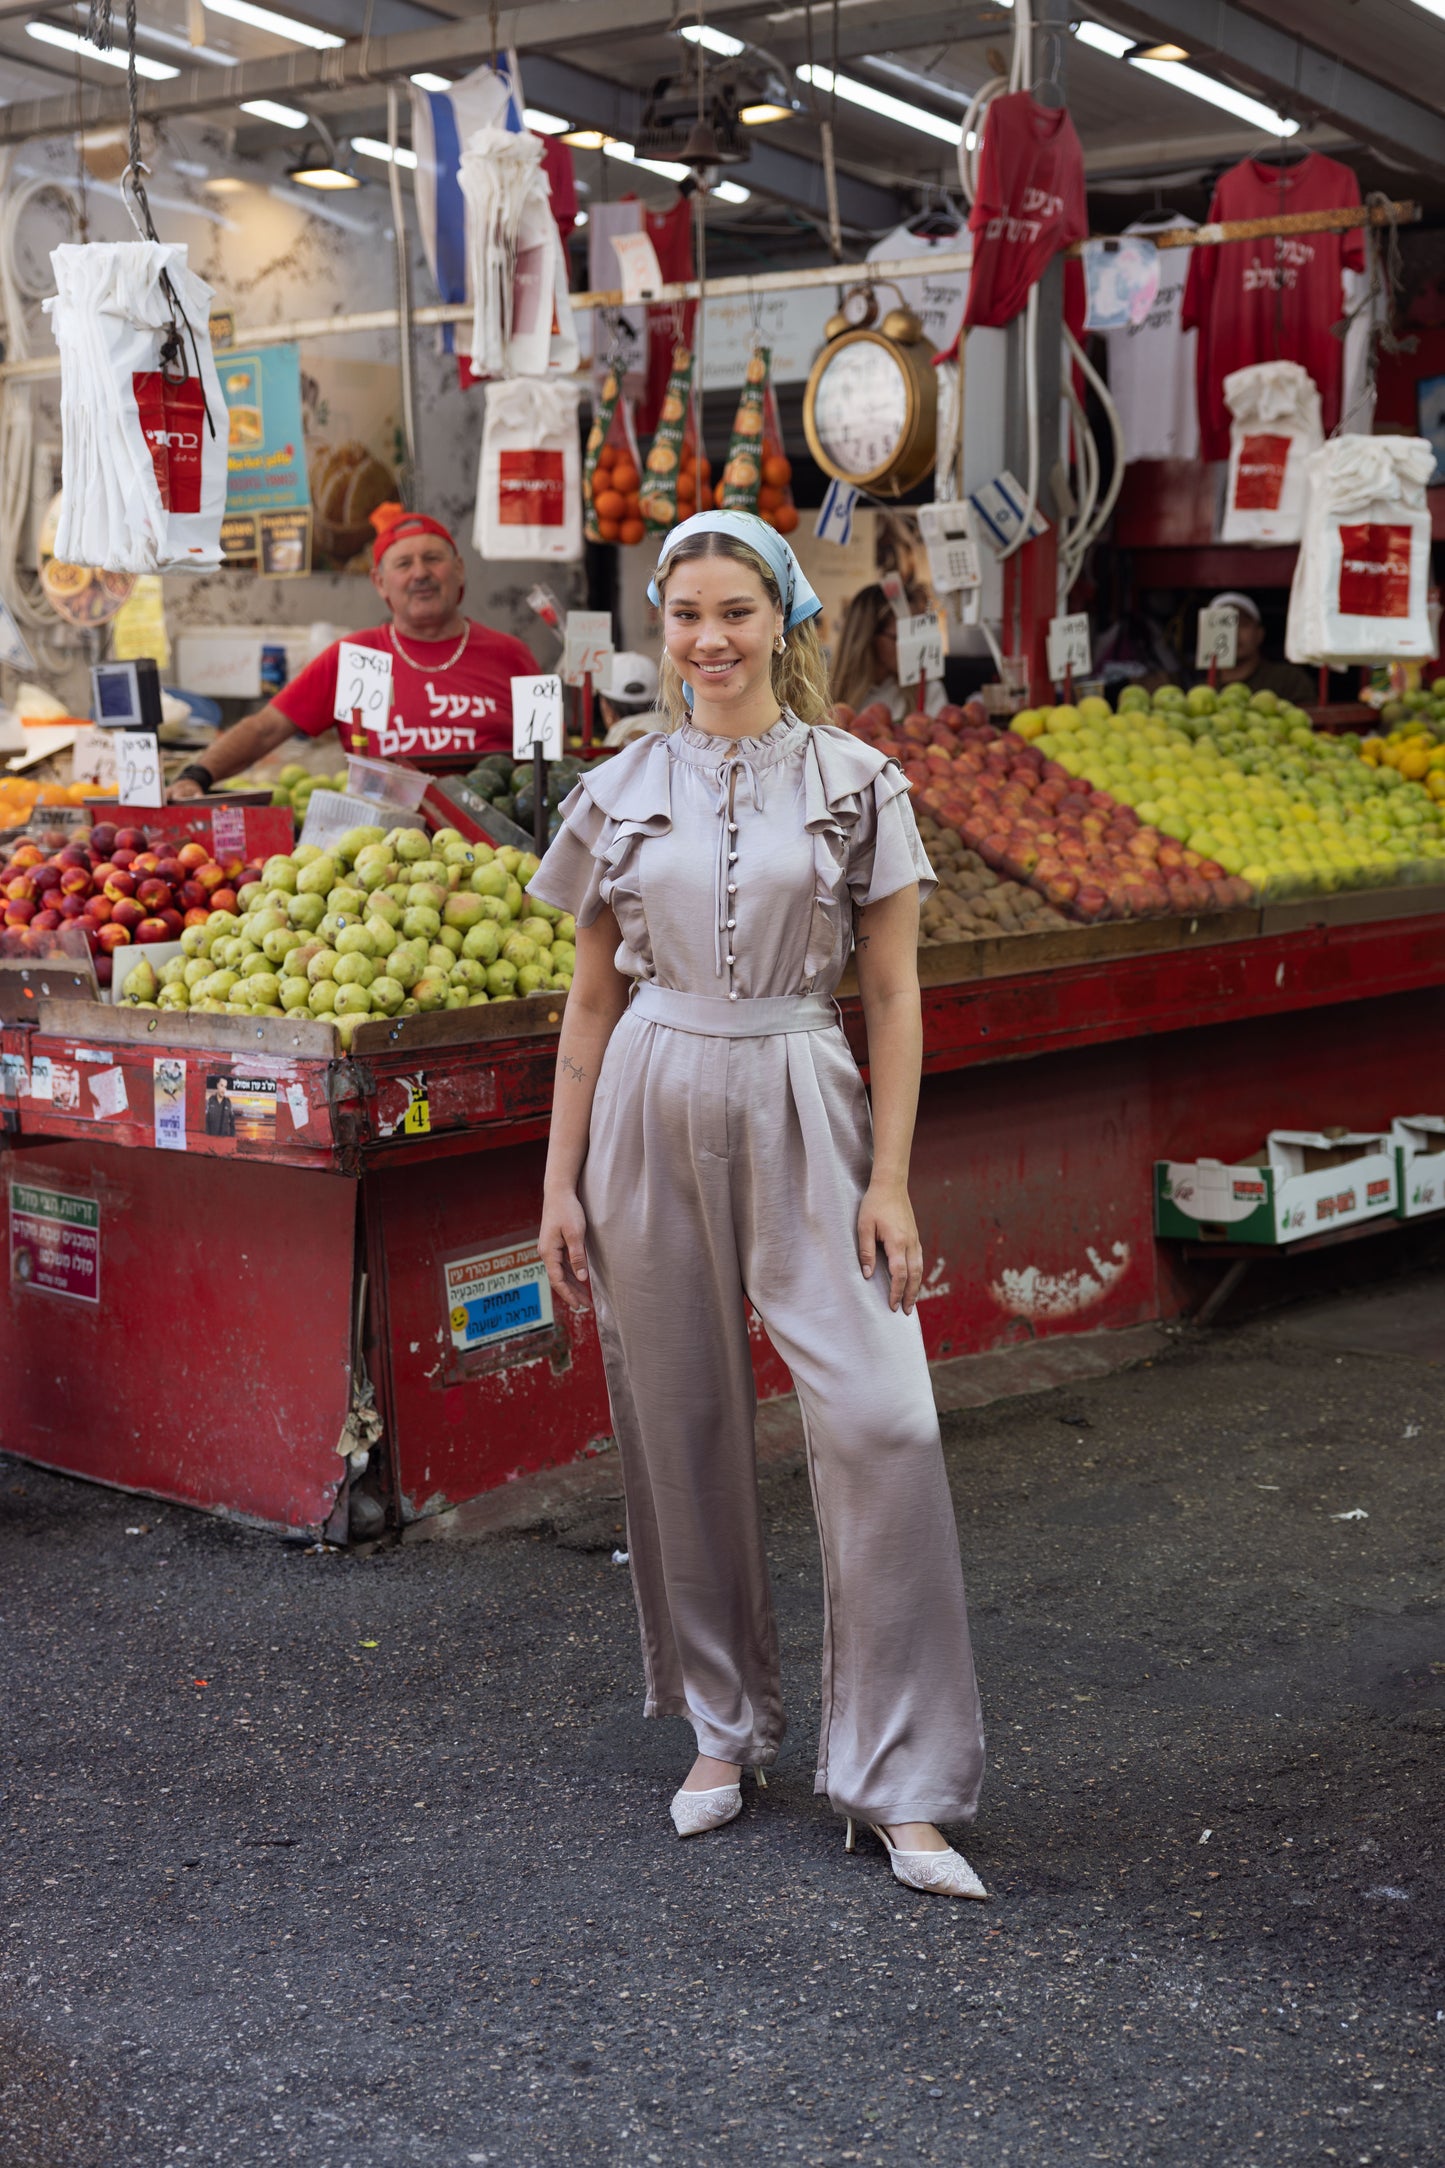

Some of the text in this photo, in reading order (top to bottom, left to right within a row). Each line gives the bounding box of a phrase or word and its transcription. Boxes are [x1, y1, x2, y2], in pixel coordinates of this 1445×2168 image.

[424, 681, 497, 718] ינעל
[377, 714, 477, 757] העולם
[412, 1104, 425, 1127] 4
